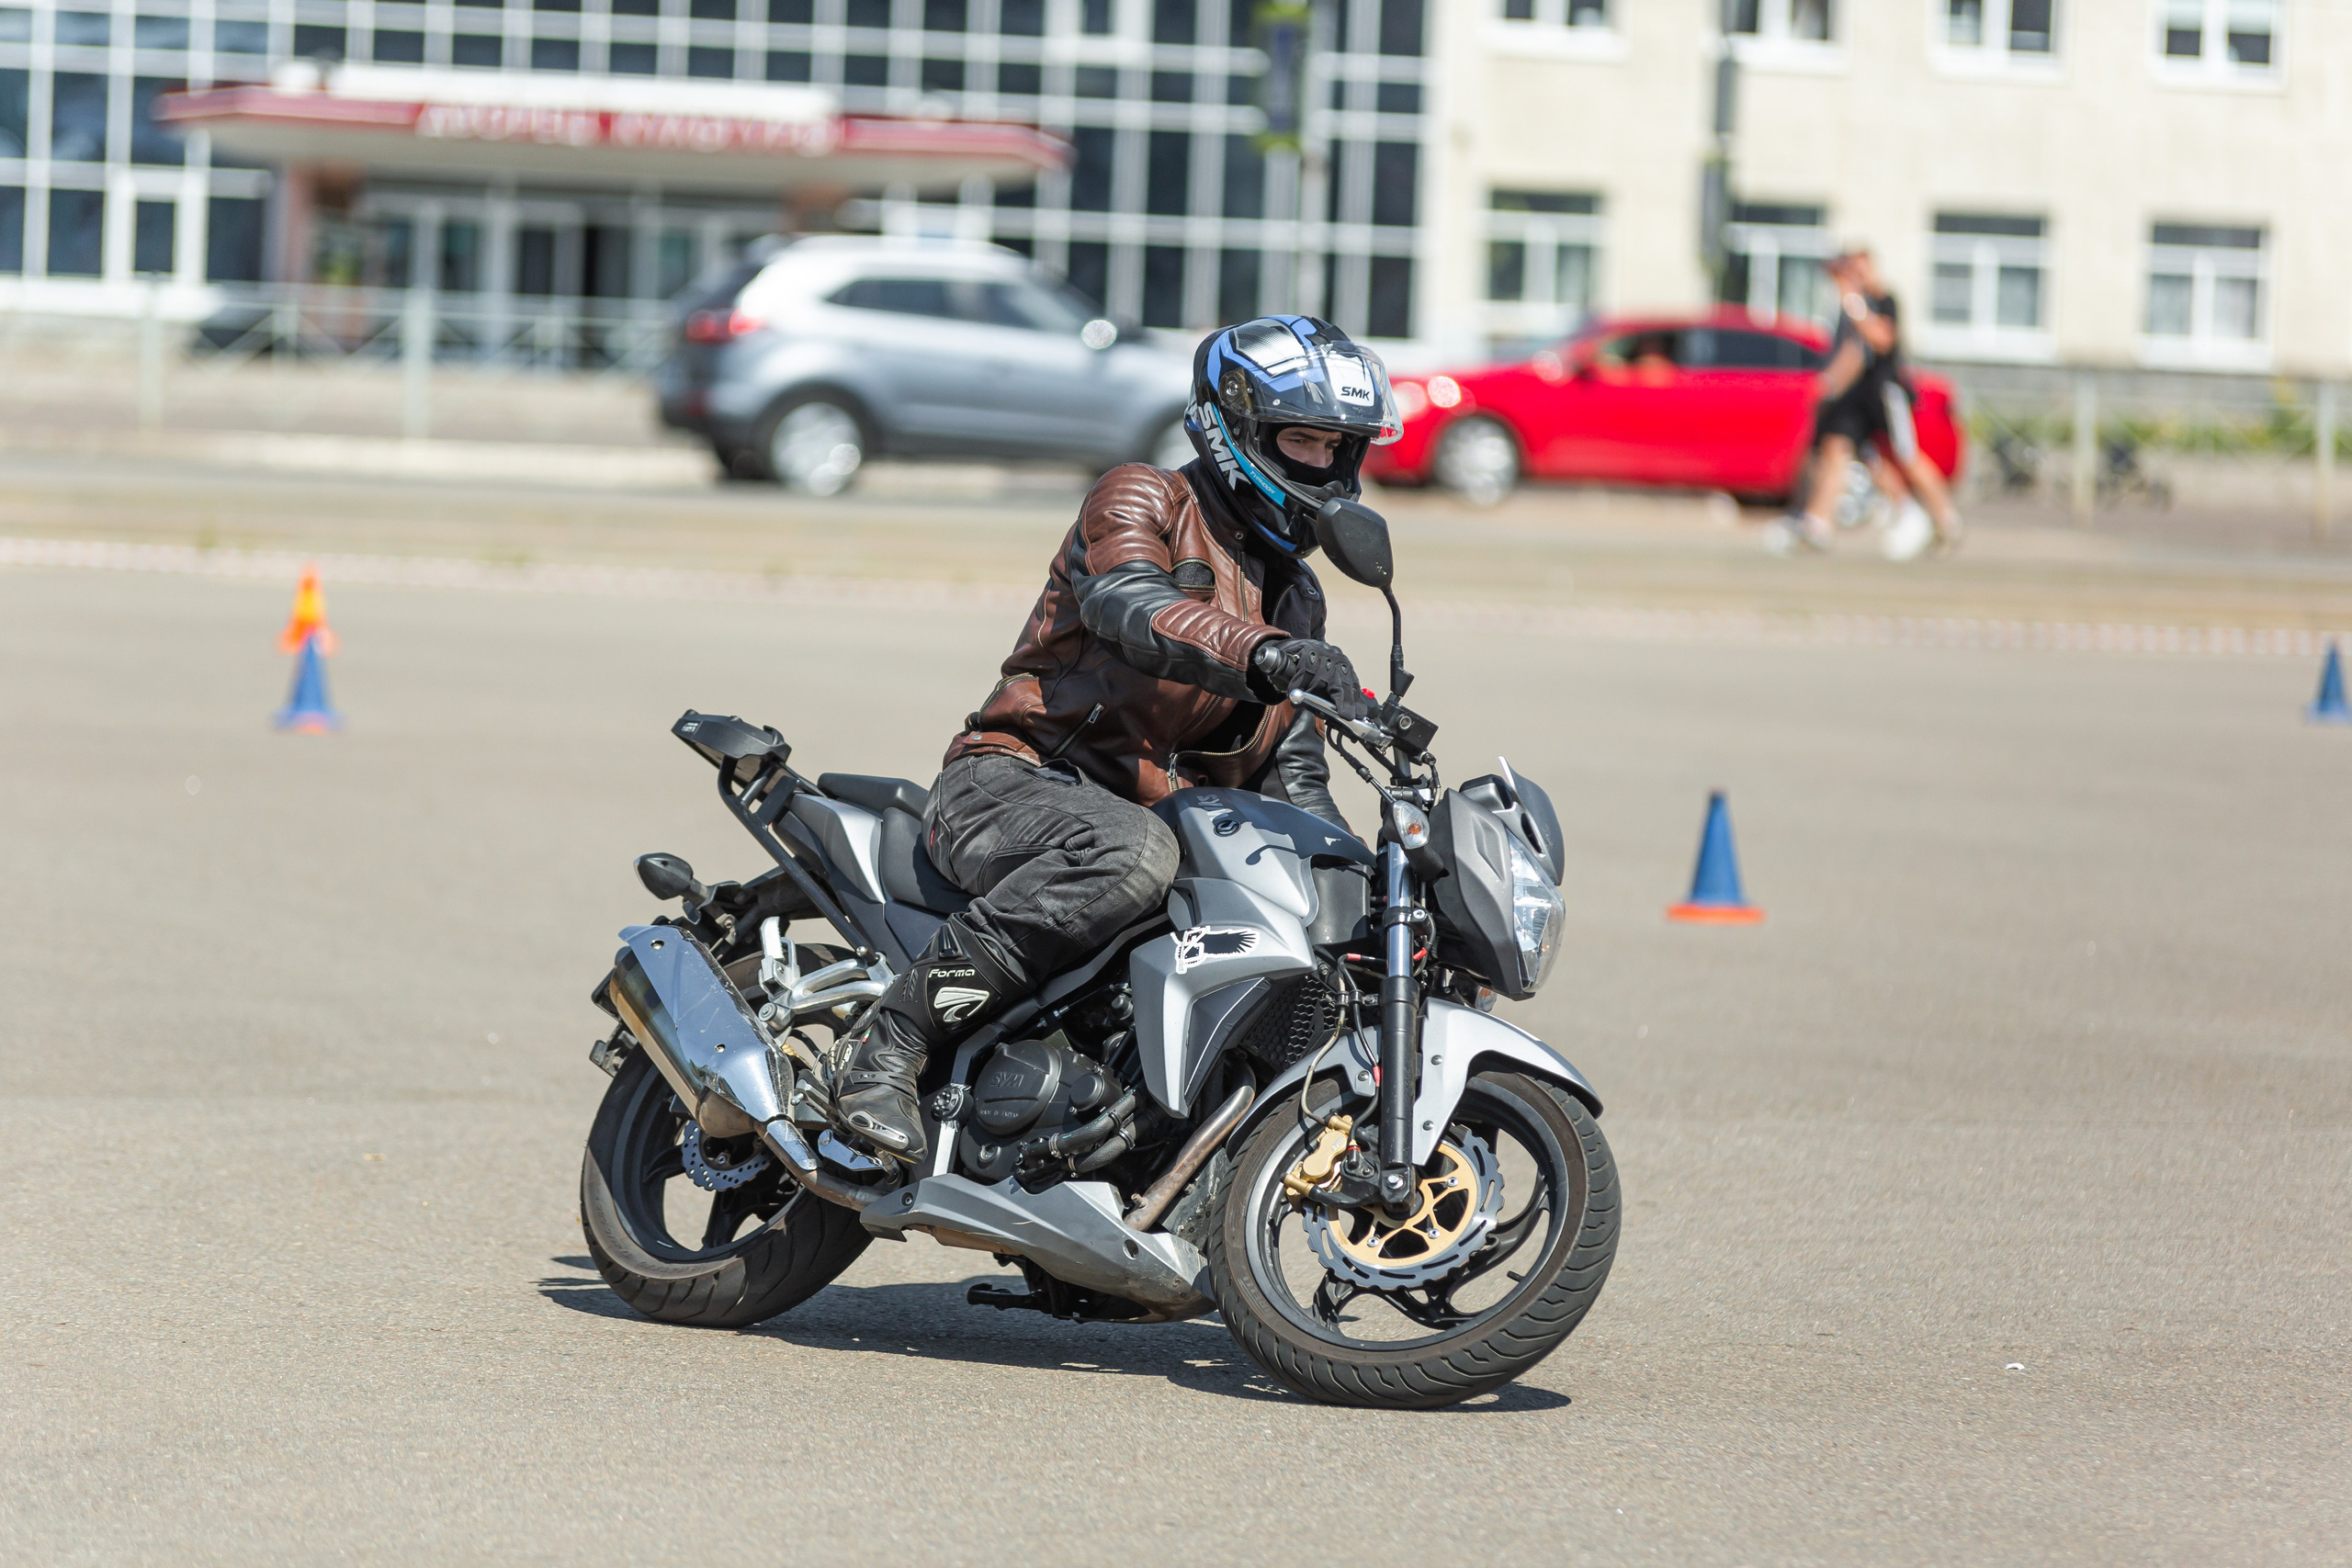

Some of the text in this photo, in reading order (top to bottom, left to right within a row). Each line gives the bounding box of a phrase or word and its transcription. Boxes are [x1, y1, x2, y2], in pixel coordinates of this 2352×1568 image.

[1340, 386, 1371, 401] SMK
[1198, 401, 1251, 491] SMK
[1250, 470, 1276, 494] TYPHOON
[989, 1071, 1024, 1088] SYM
